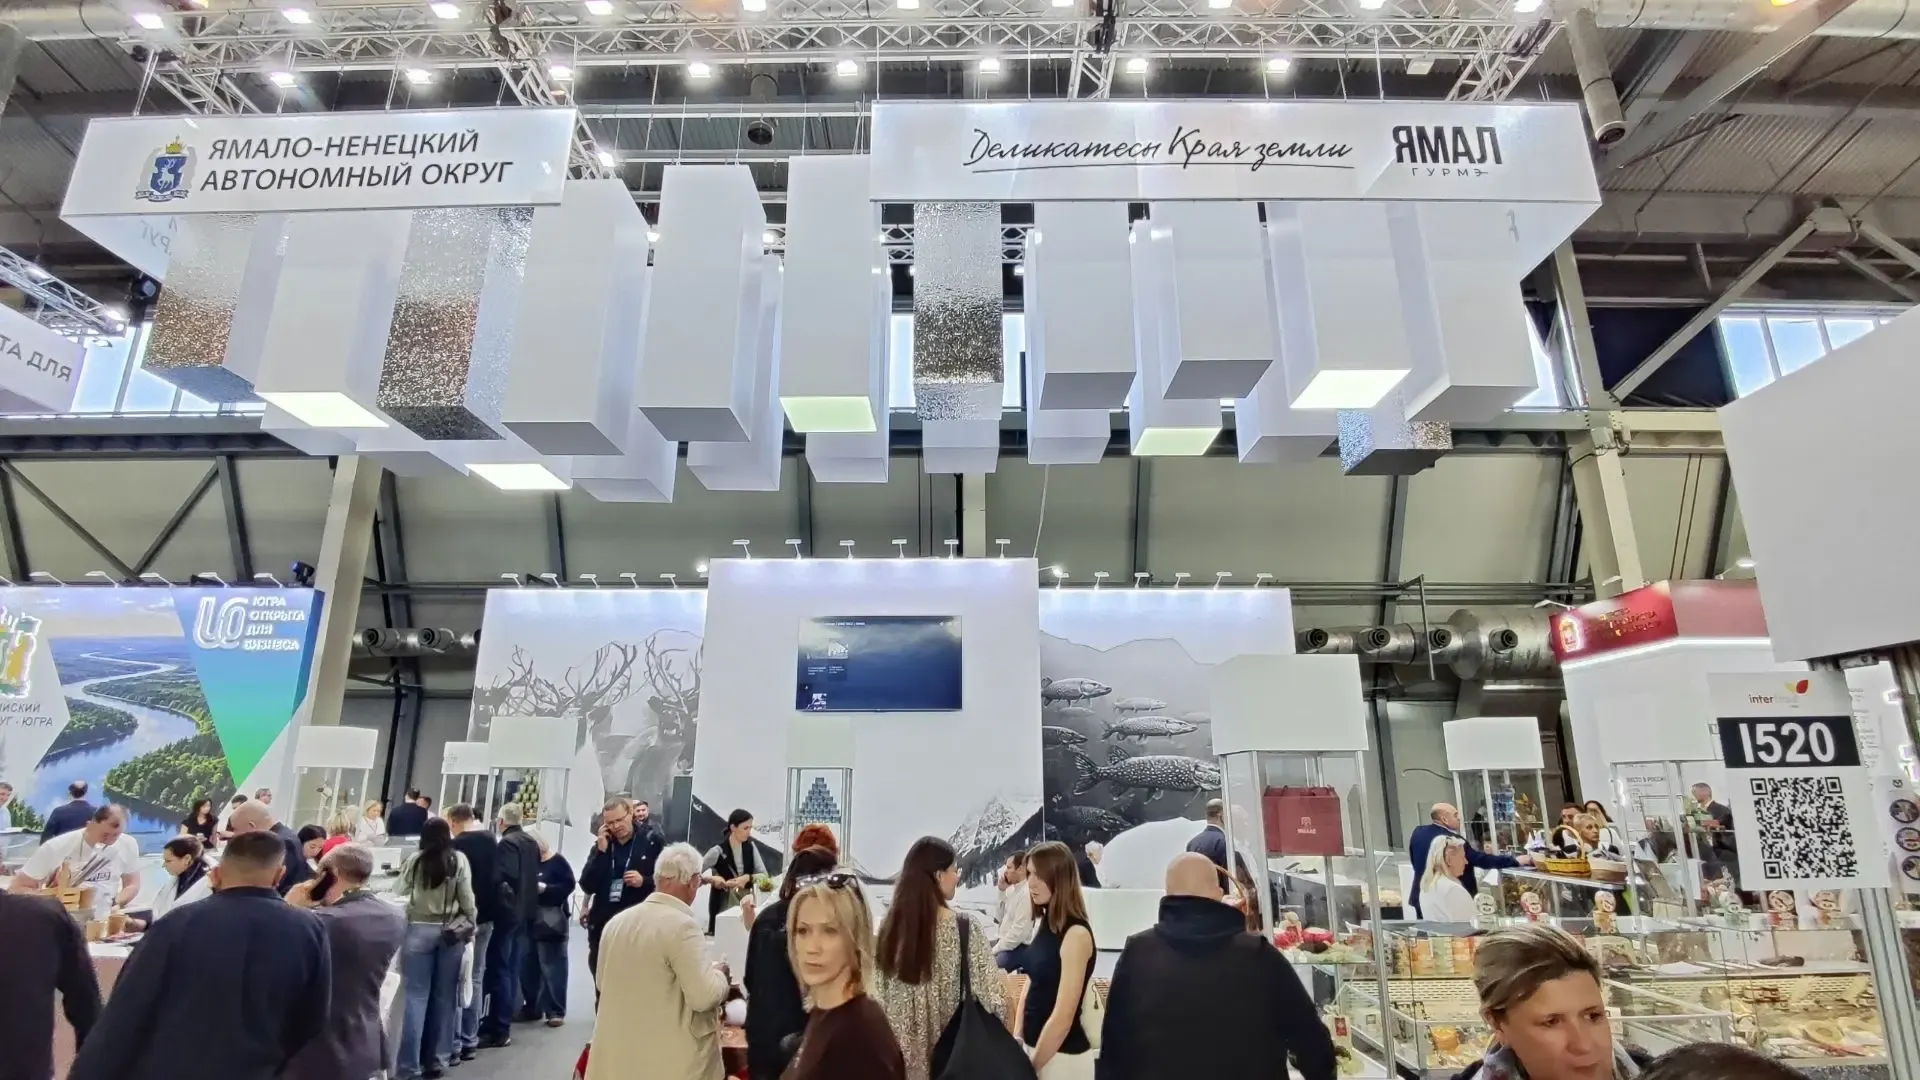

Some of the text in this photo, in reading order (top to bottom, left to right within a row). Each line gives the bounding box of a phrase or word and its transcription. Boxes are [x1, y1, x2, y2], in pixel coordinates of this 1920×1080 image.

[208, 128, 479, 159] ЯМАЛО-НЕНЕЦКИЙ
[963, 126, 1352, 171] Деликатесы Края земли
[1392, 125, 1503, 164] ЯМАЛ
[199, 162, 513, 191] АВТОНОМНЫЙ ОКРУГ
[1411, 168, 1489, 177] ГУРМЭ
[26, 351, 72, 382] ДЛЯ
[252, 596, 287, 607] ЮГРА
[249, 609, 305, 621] ОТКРЫТА
[246, 623, 273, 636] ДЛЯ
[243, 639, 300, 651] БИЗНЕСА
[21, 716, 53, 727] ЮГРА
